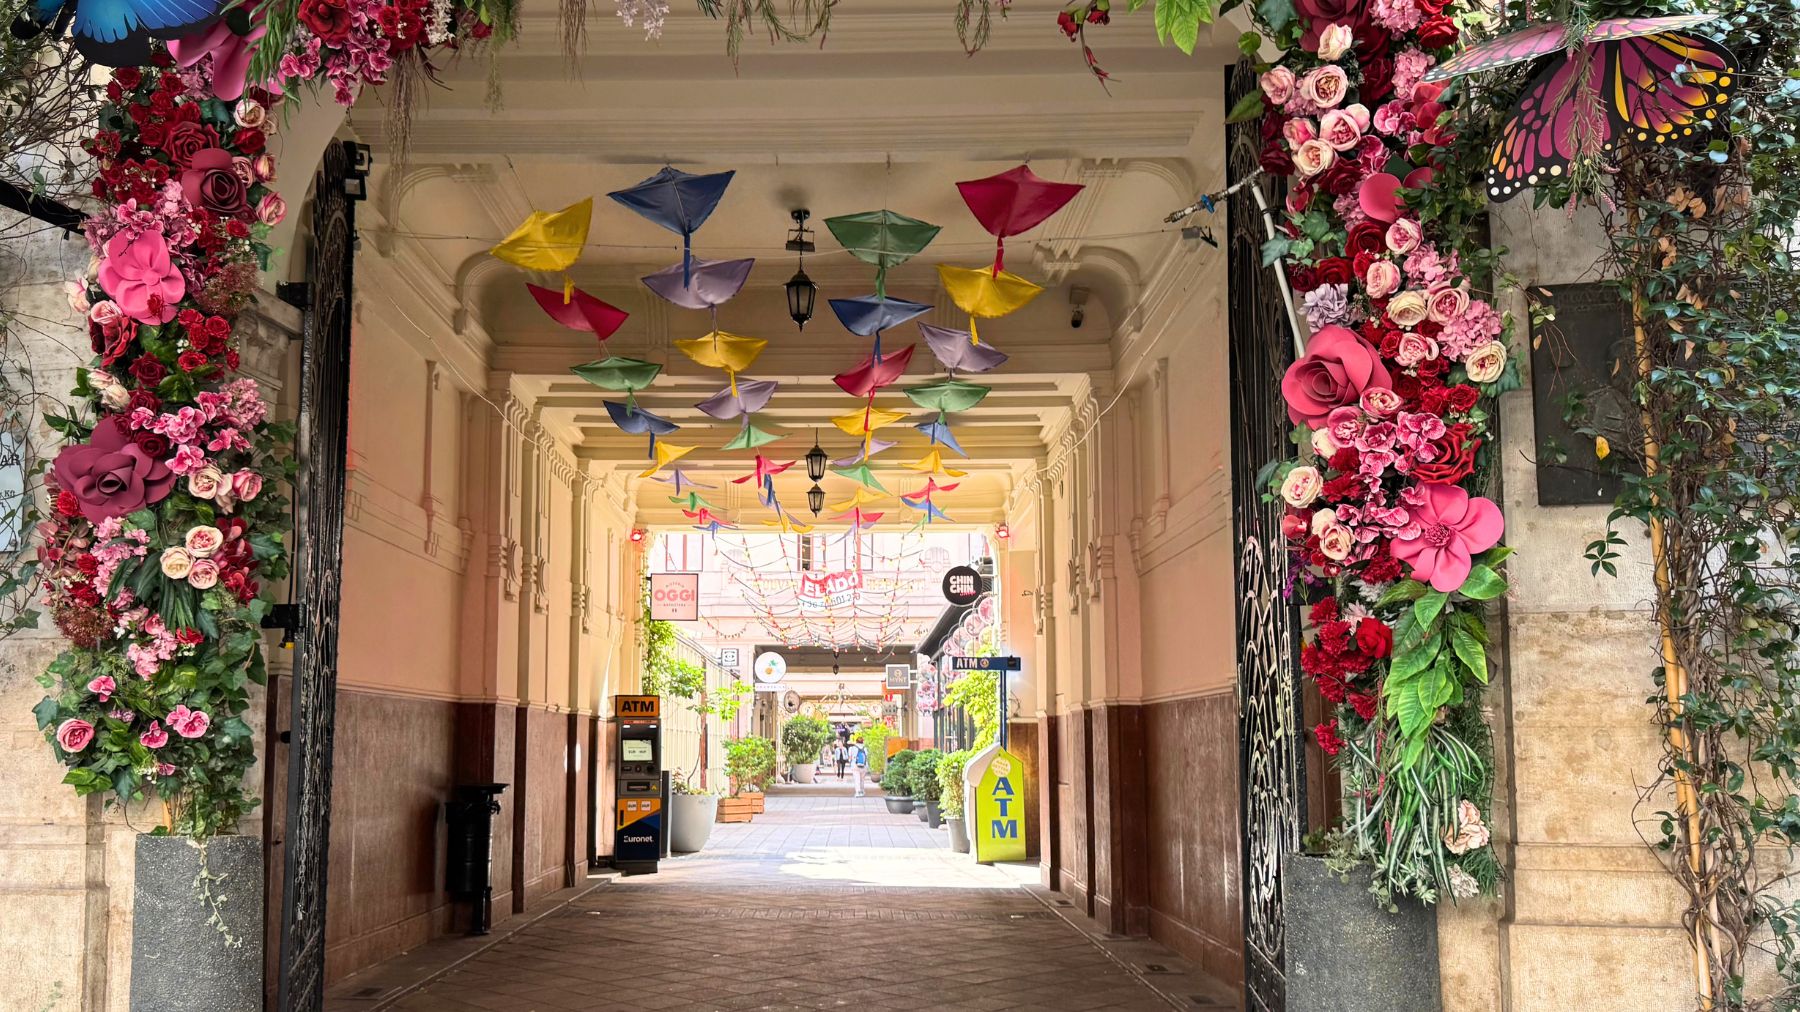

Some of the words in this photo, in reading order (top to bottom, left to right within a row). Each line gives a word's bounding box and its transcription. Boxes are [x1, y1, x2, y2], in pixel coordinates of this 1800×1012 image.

[949, 575, 974, 584] CHIN
[949, 584, 974, 594] CHIN
[654, 589, 695, 602] OGGI
[956, 658, 978, 669] ATM
[621, 700, 655, 712] ATM
[991, 777, 1018, 839] ATM
